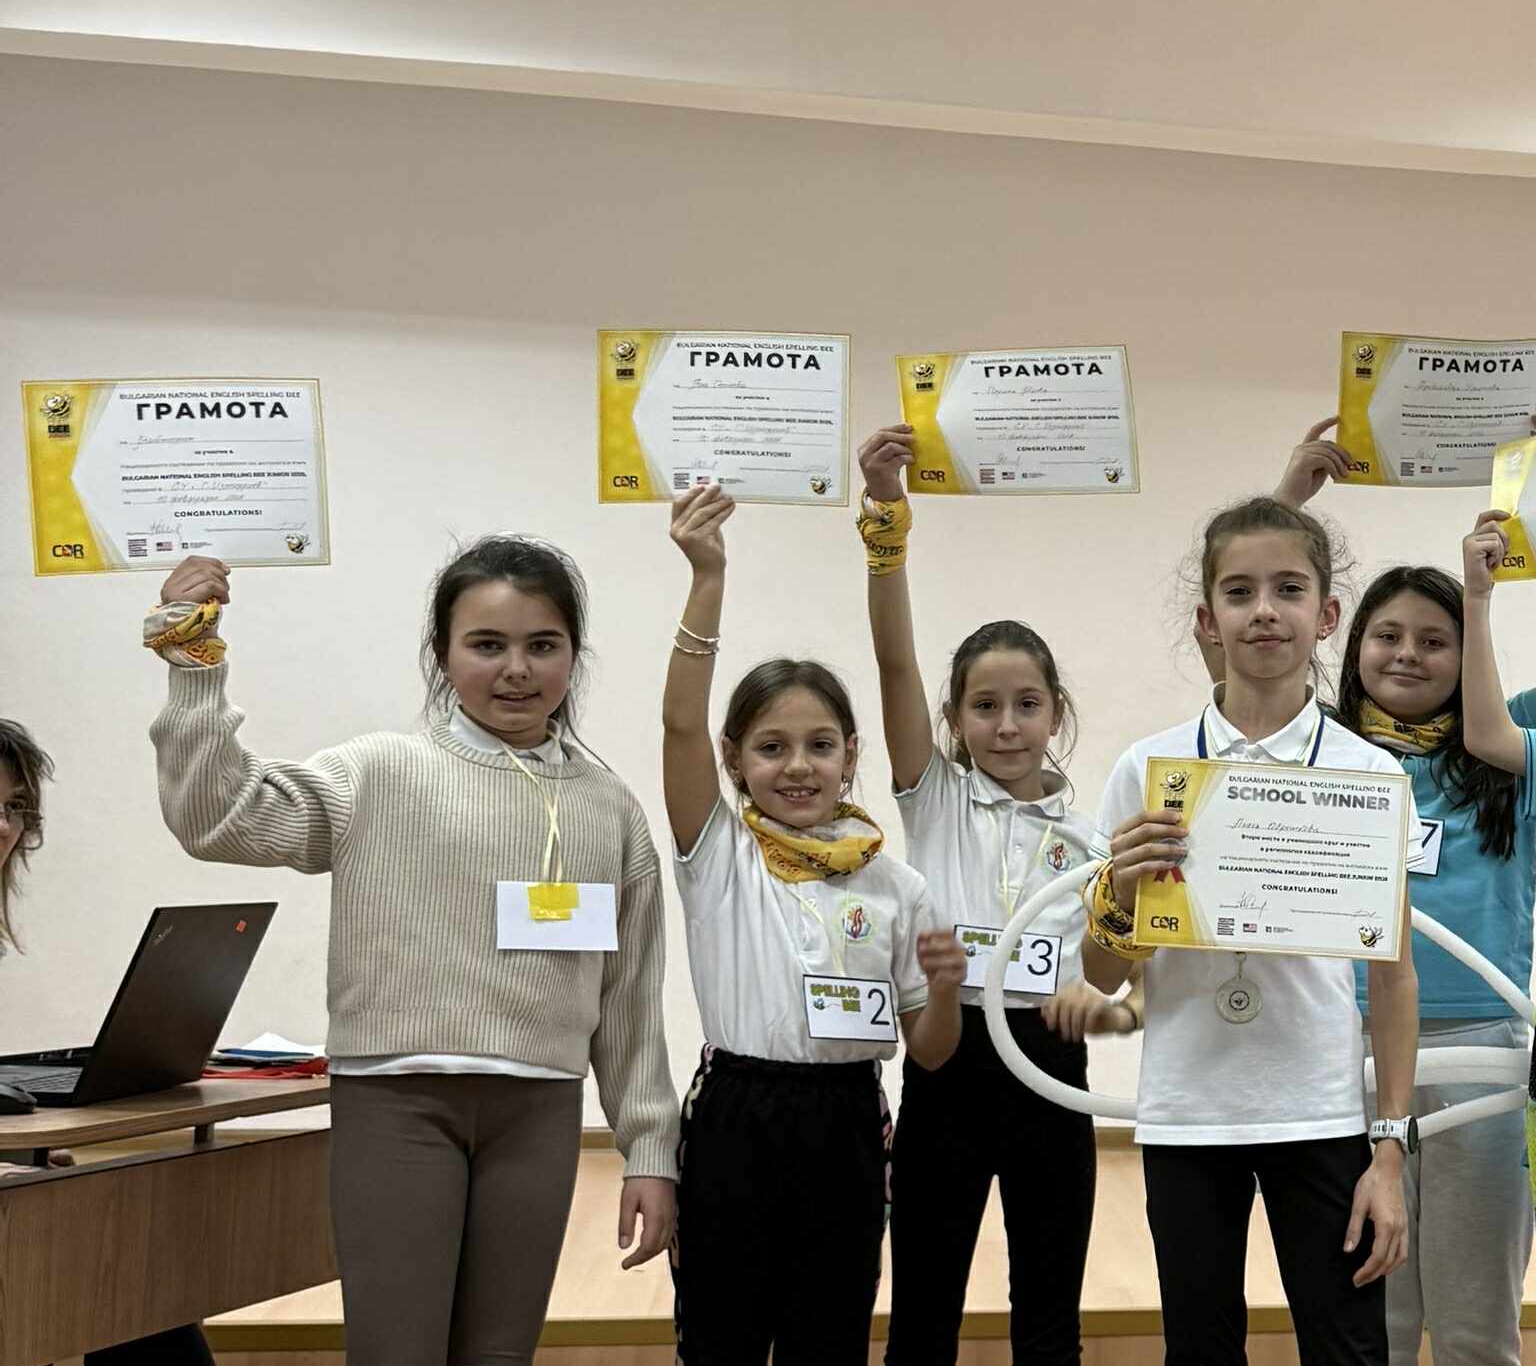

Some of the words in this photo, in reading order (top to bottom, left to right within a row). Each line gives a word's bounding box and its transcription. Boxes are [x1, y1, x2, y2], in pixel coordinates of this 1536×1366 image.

[689, 351, 821, 370] ГРАМОТА
[984, 362, 1103, 378] ГРАМОТА
[1418, 357, 1524, 373] ГРАМОТА
[136, 401, 289, 421] ГРАМОТА
[174, 509, 263, 518] CONGRATULATIONS!
[1227, 785, 1307, 805] SCHOOL
[1312, 791, 1390, 811] WINNER
[1420, 821, 1439, 848] 7
[1261, 883, 1338, 894] CONGRATULATIONS!
[1027, 939, 1053, 976] 3
[867, 988, 890, 1026] 2
